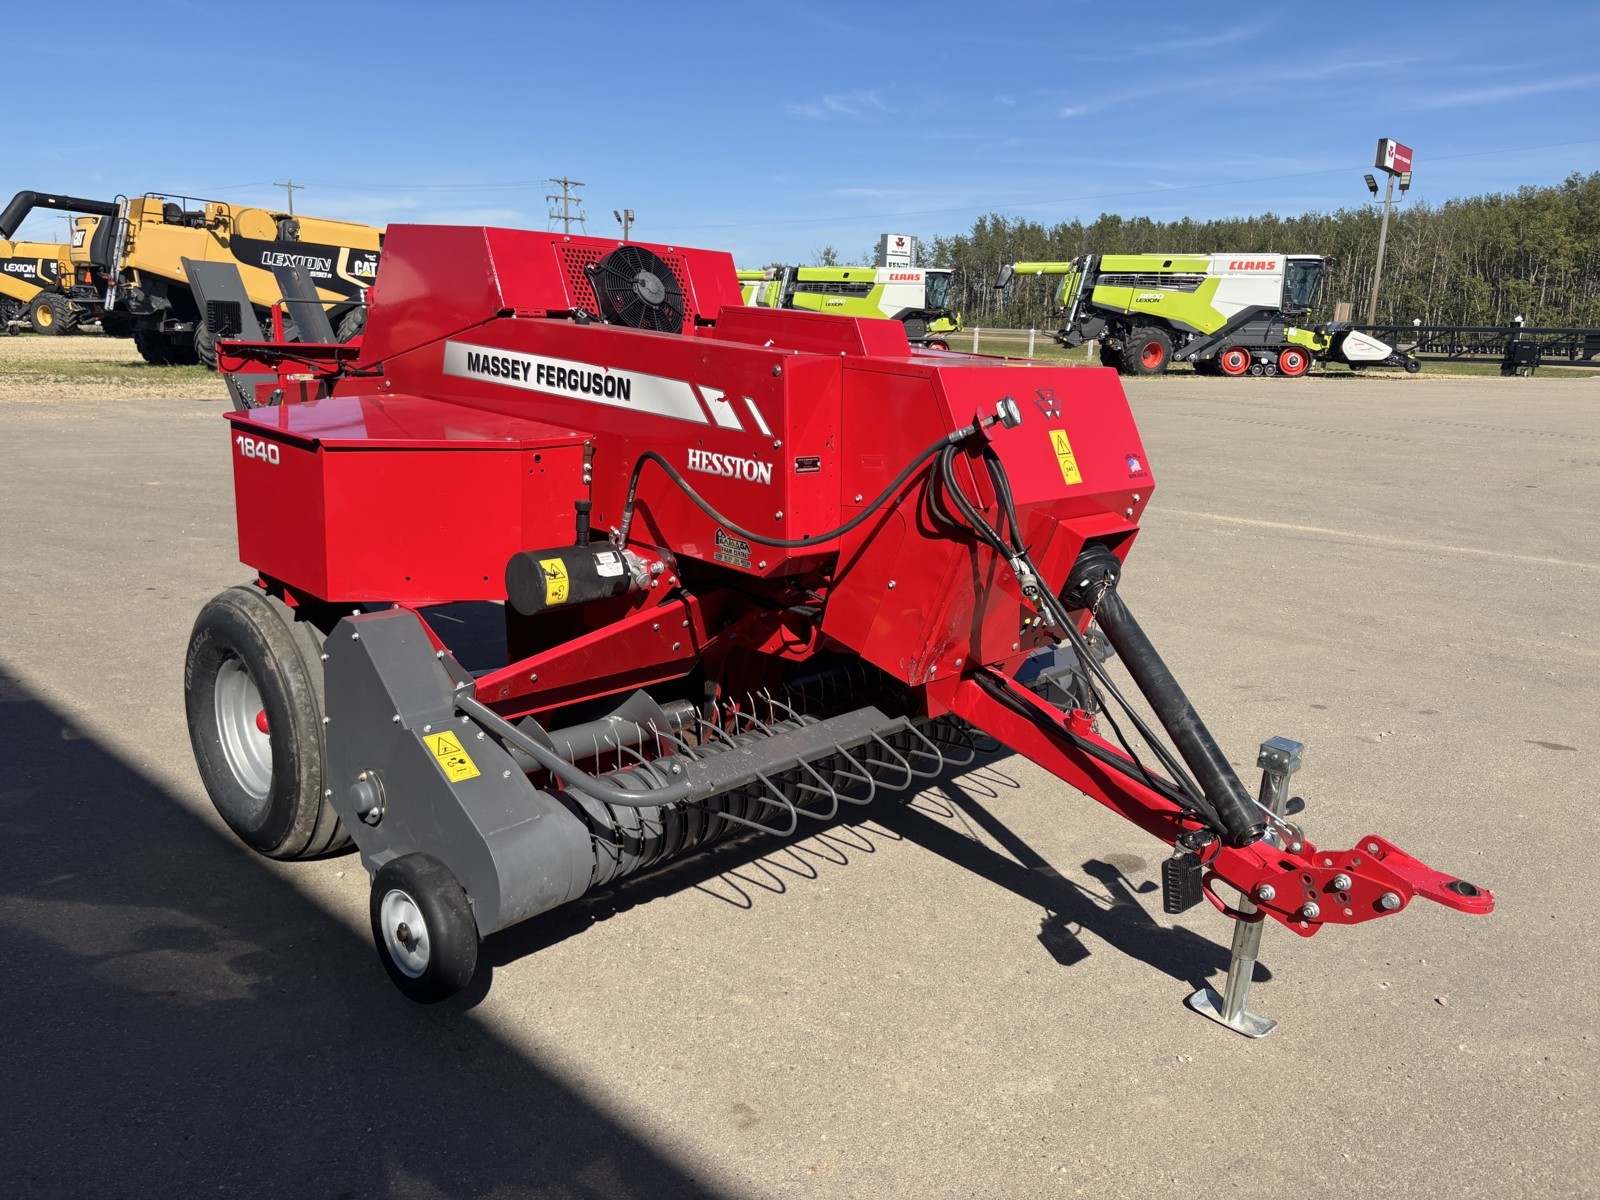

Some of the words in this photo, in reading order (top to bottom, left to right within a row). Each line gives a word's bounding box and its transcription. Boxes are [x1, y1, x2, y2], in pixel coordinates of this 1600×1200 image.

[4, 263, 36, 273] LEXION
[261, 251, 332, 271] LEXION
[354, 260, 378, 277] CAT
[1229, 261, 1276, 270] CLAAS
[889, 273, 921, 281] CLAAS
[467, 352, 531, 382] MASSEY
[537, 364, 631, 401] FERGUSON
[236, 436, 280, 465] 1840
[687, 448, 774, 485] HESSTON
